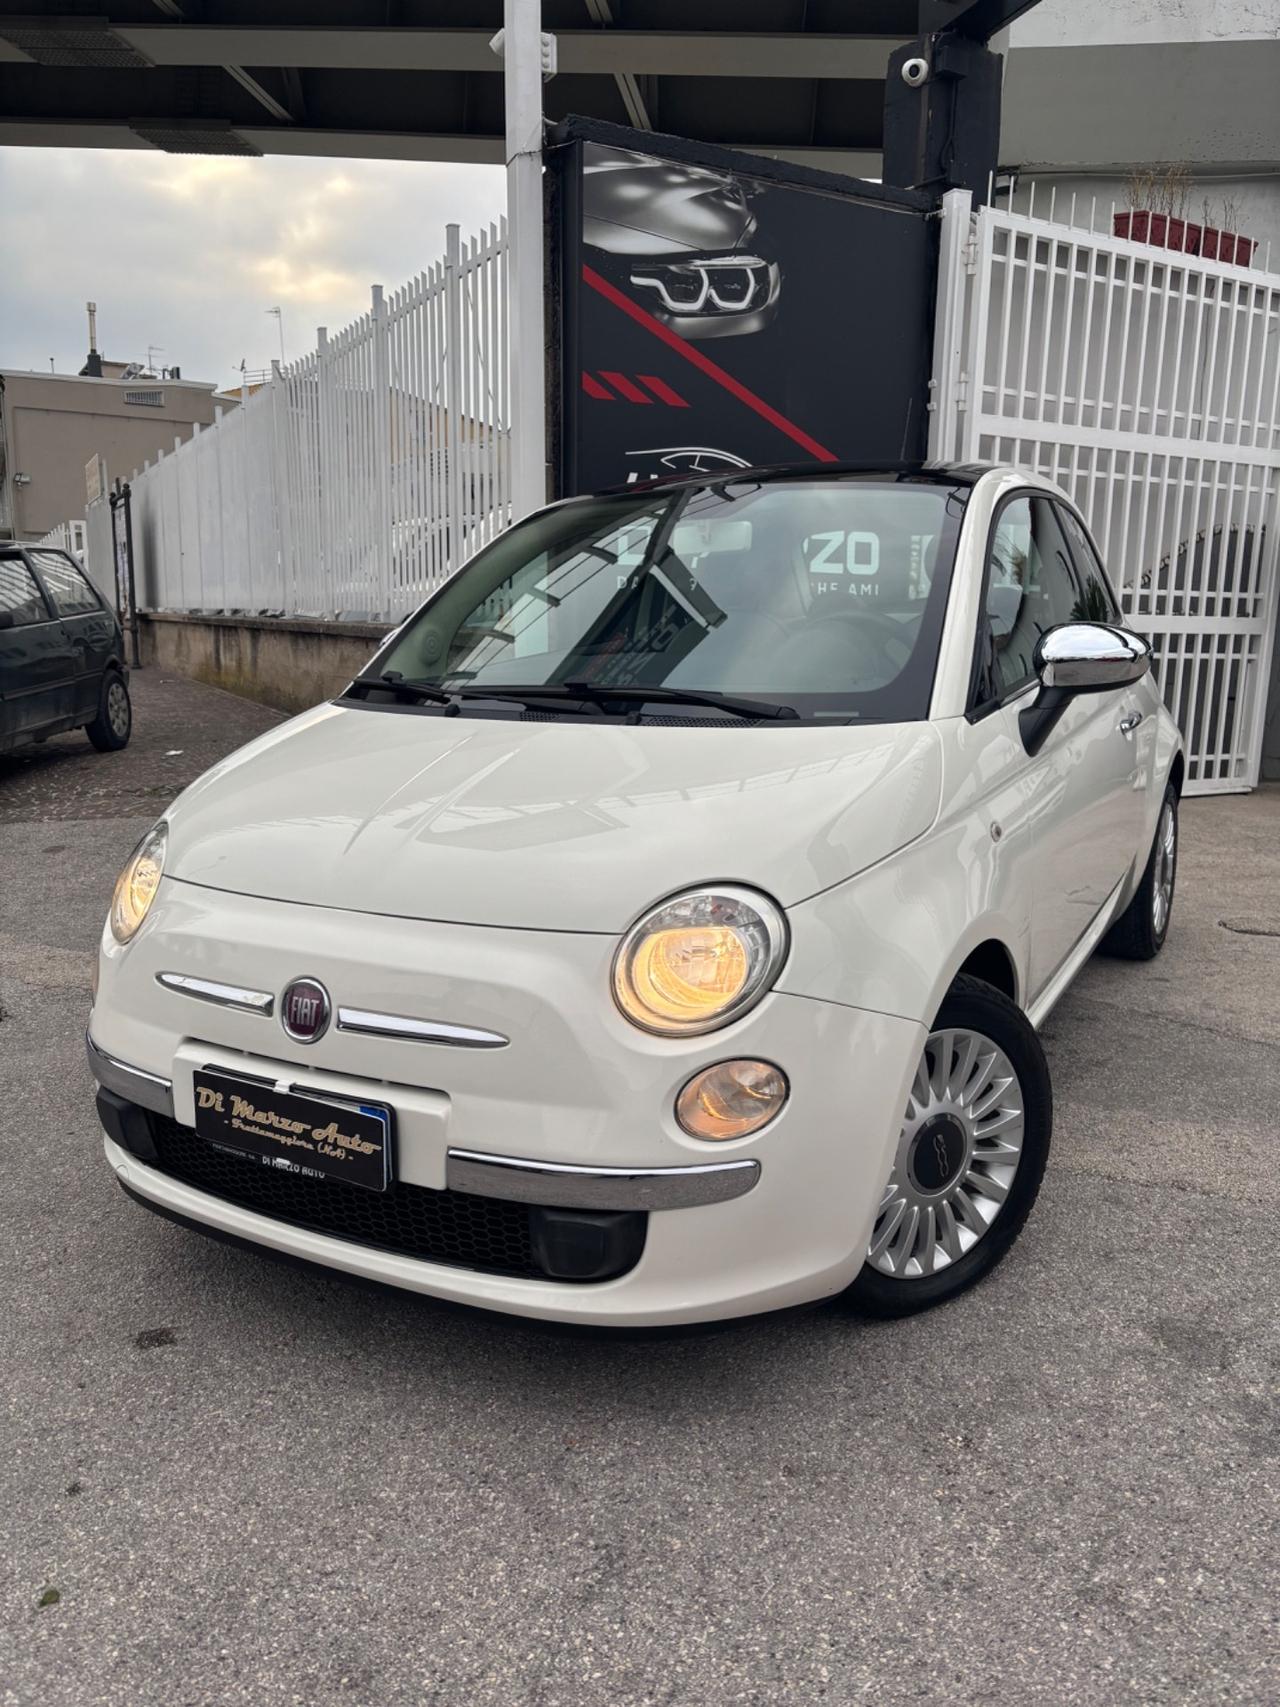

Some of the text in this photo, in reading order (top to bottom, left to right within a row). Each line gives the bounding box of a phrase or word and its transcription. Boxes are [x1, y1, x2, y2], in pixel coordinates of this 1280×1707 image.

[803, 530, 880, 575] ZO
[291, 996, 319, 1026] FIAT
[196, 1086, 382, 1155] Di Marzo Auto
